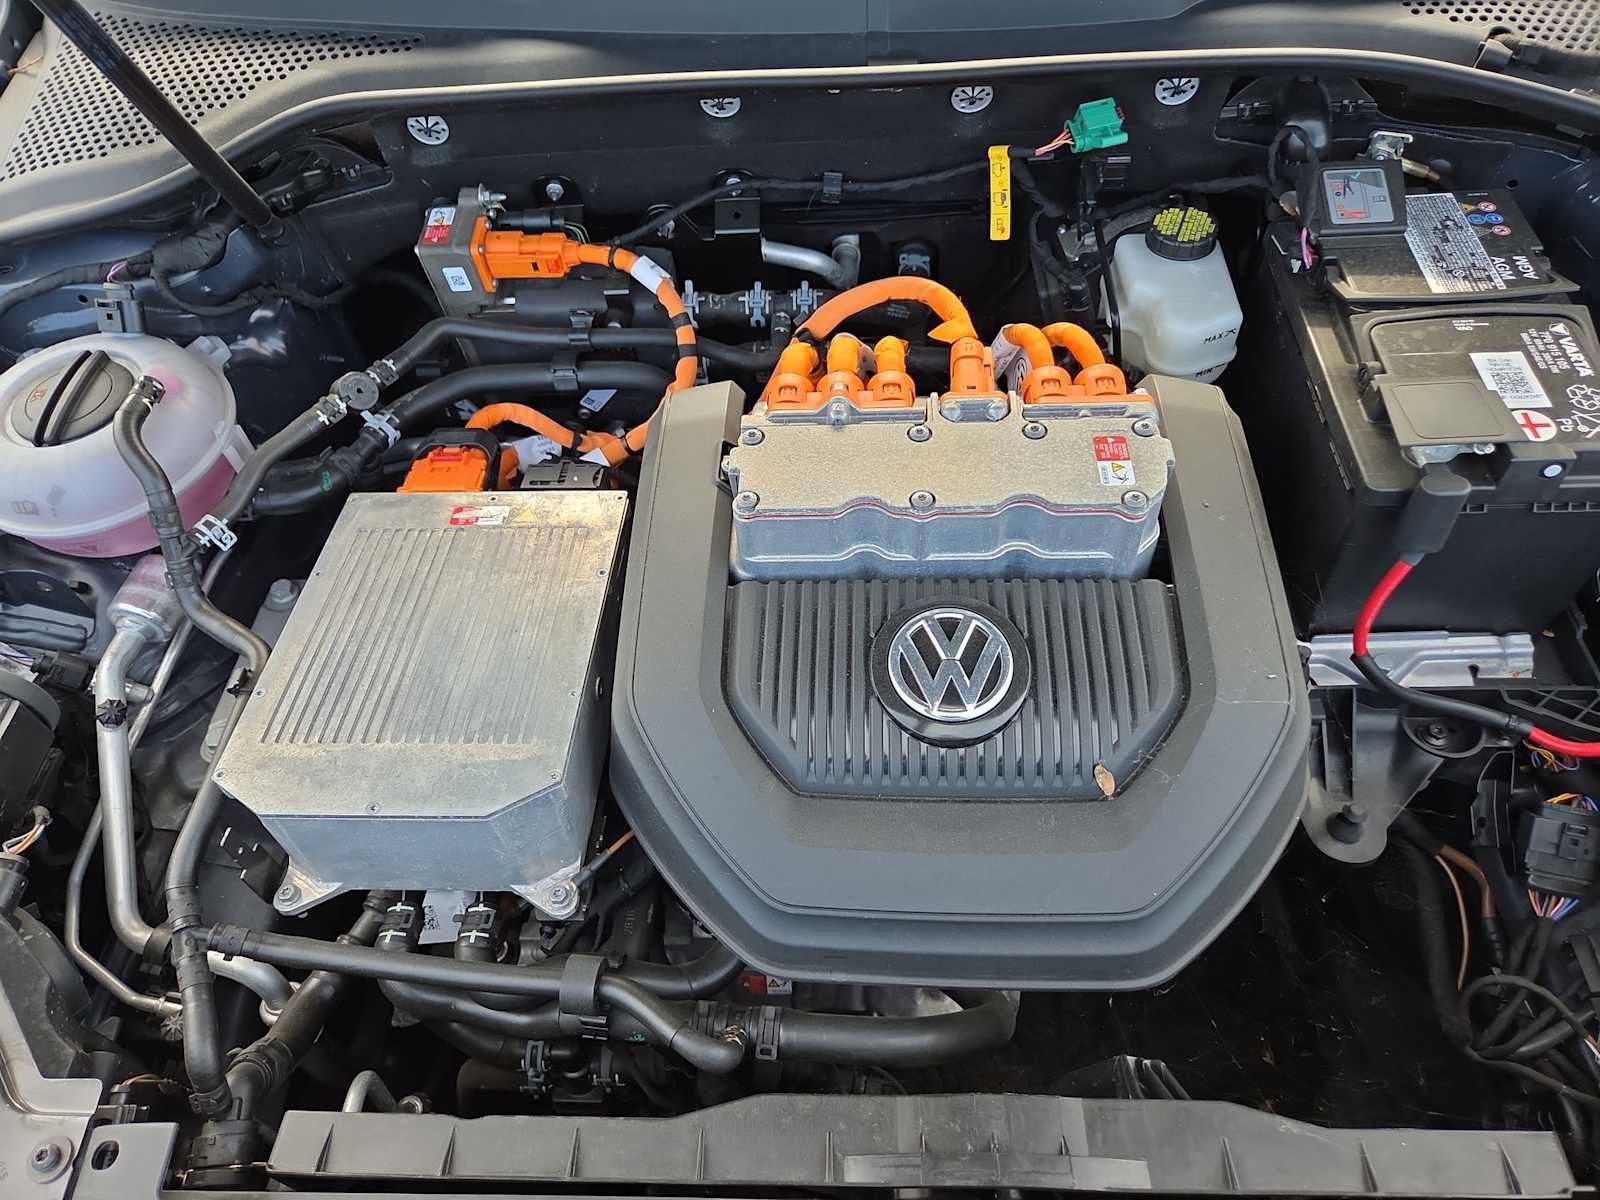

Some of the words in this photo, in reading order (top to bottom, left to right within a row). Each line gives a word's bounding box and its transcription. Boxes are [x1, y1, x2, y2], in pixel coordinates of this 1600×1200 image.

[1490, 256, 1518, 280] AGM
[1512, 255, 1540, 280] AGM
[1203, 331, 1224, 345] MAX
[1546, 343, 1562, 356] 915
[1558, 336, 1594, 377] VARTA
[1556, 418, 1575, 432] Pb
